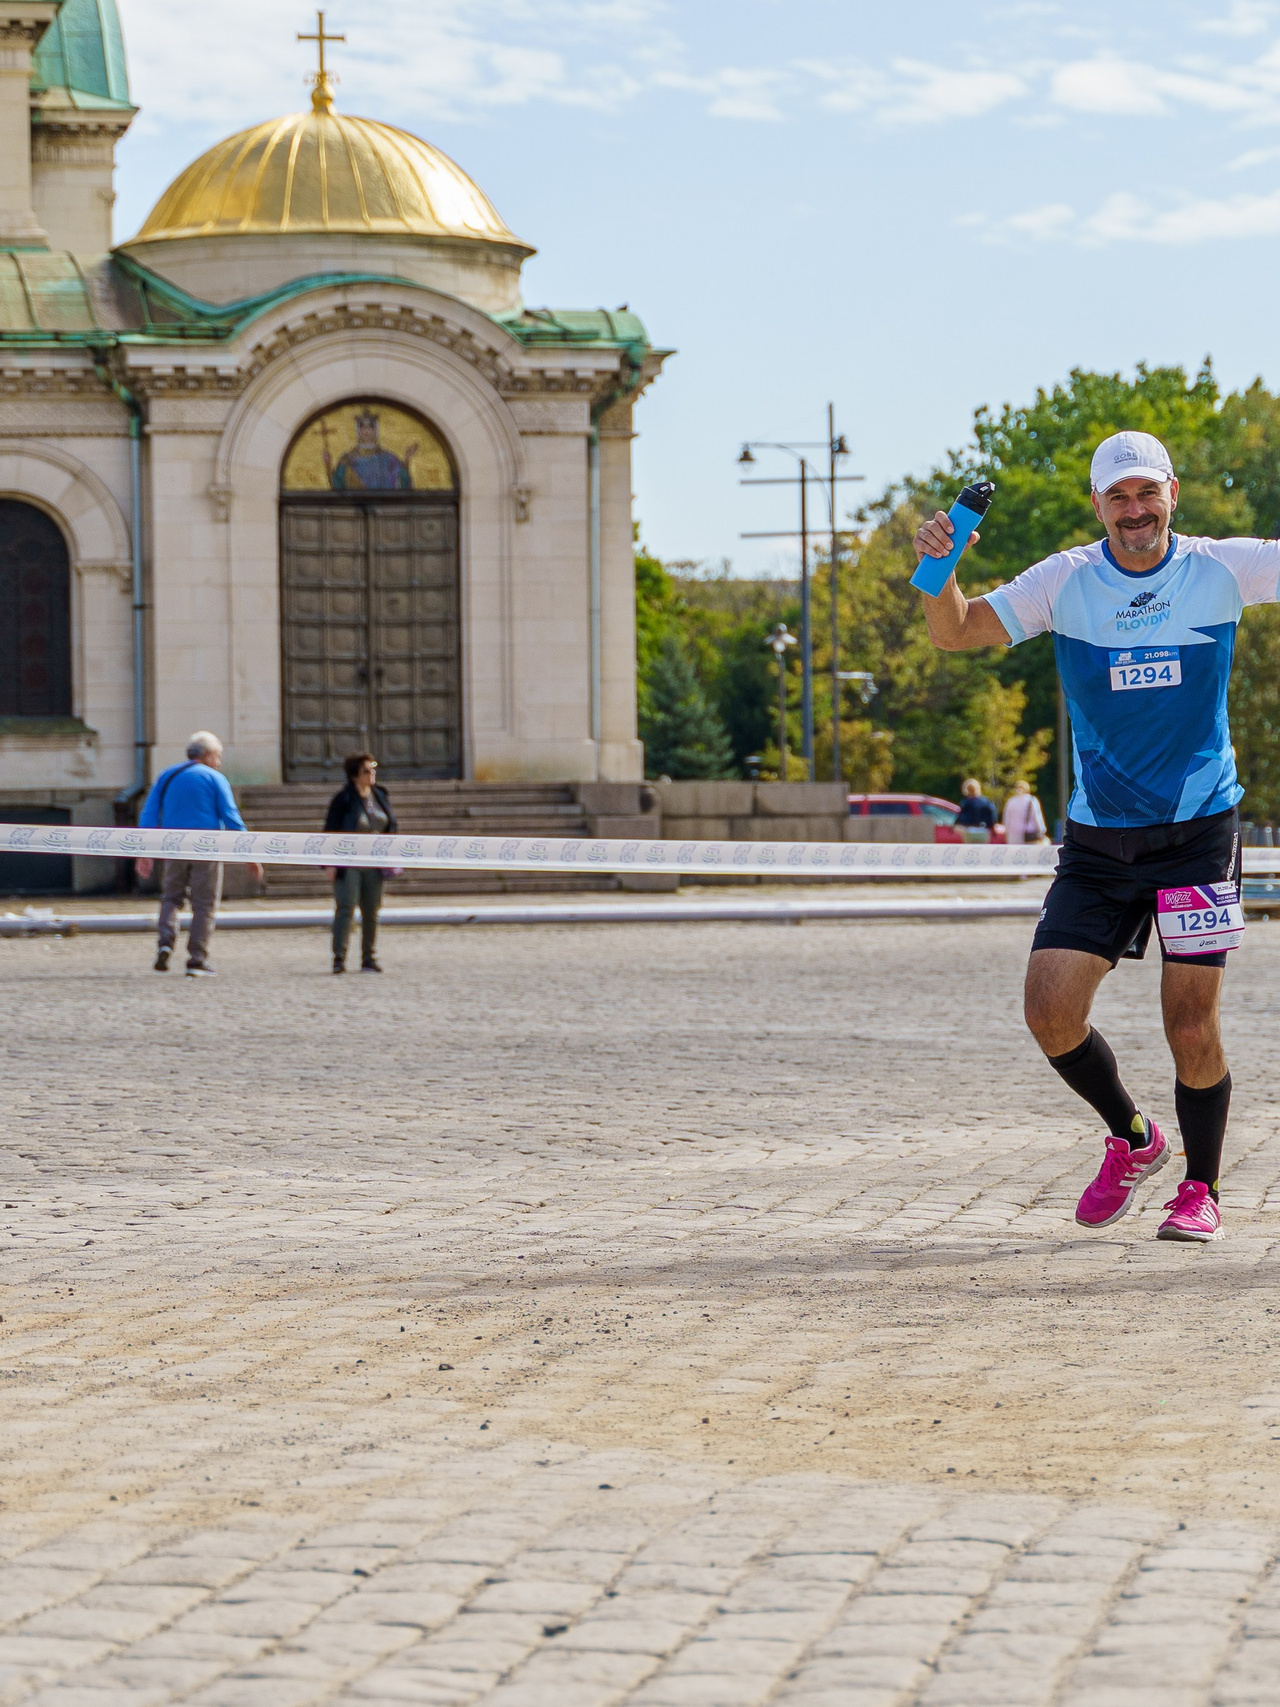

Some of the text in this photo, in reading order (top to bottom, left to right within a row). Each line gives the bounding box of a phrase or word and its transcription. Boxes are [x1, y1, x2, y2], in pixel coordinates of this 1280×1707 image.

[1116, 601, 1170, 619] MARATHON
[1116, 610, 1171, 632] PLOVDIV
[1118, 665, 1173, 686] 1294
[1177, 908, 1231, 932] 1294
